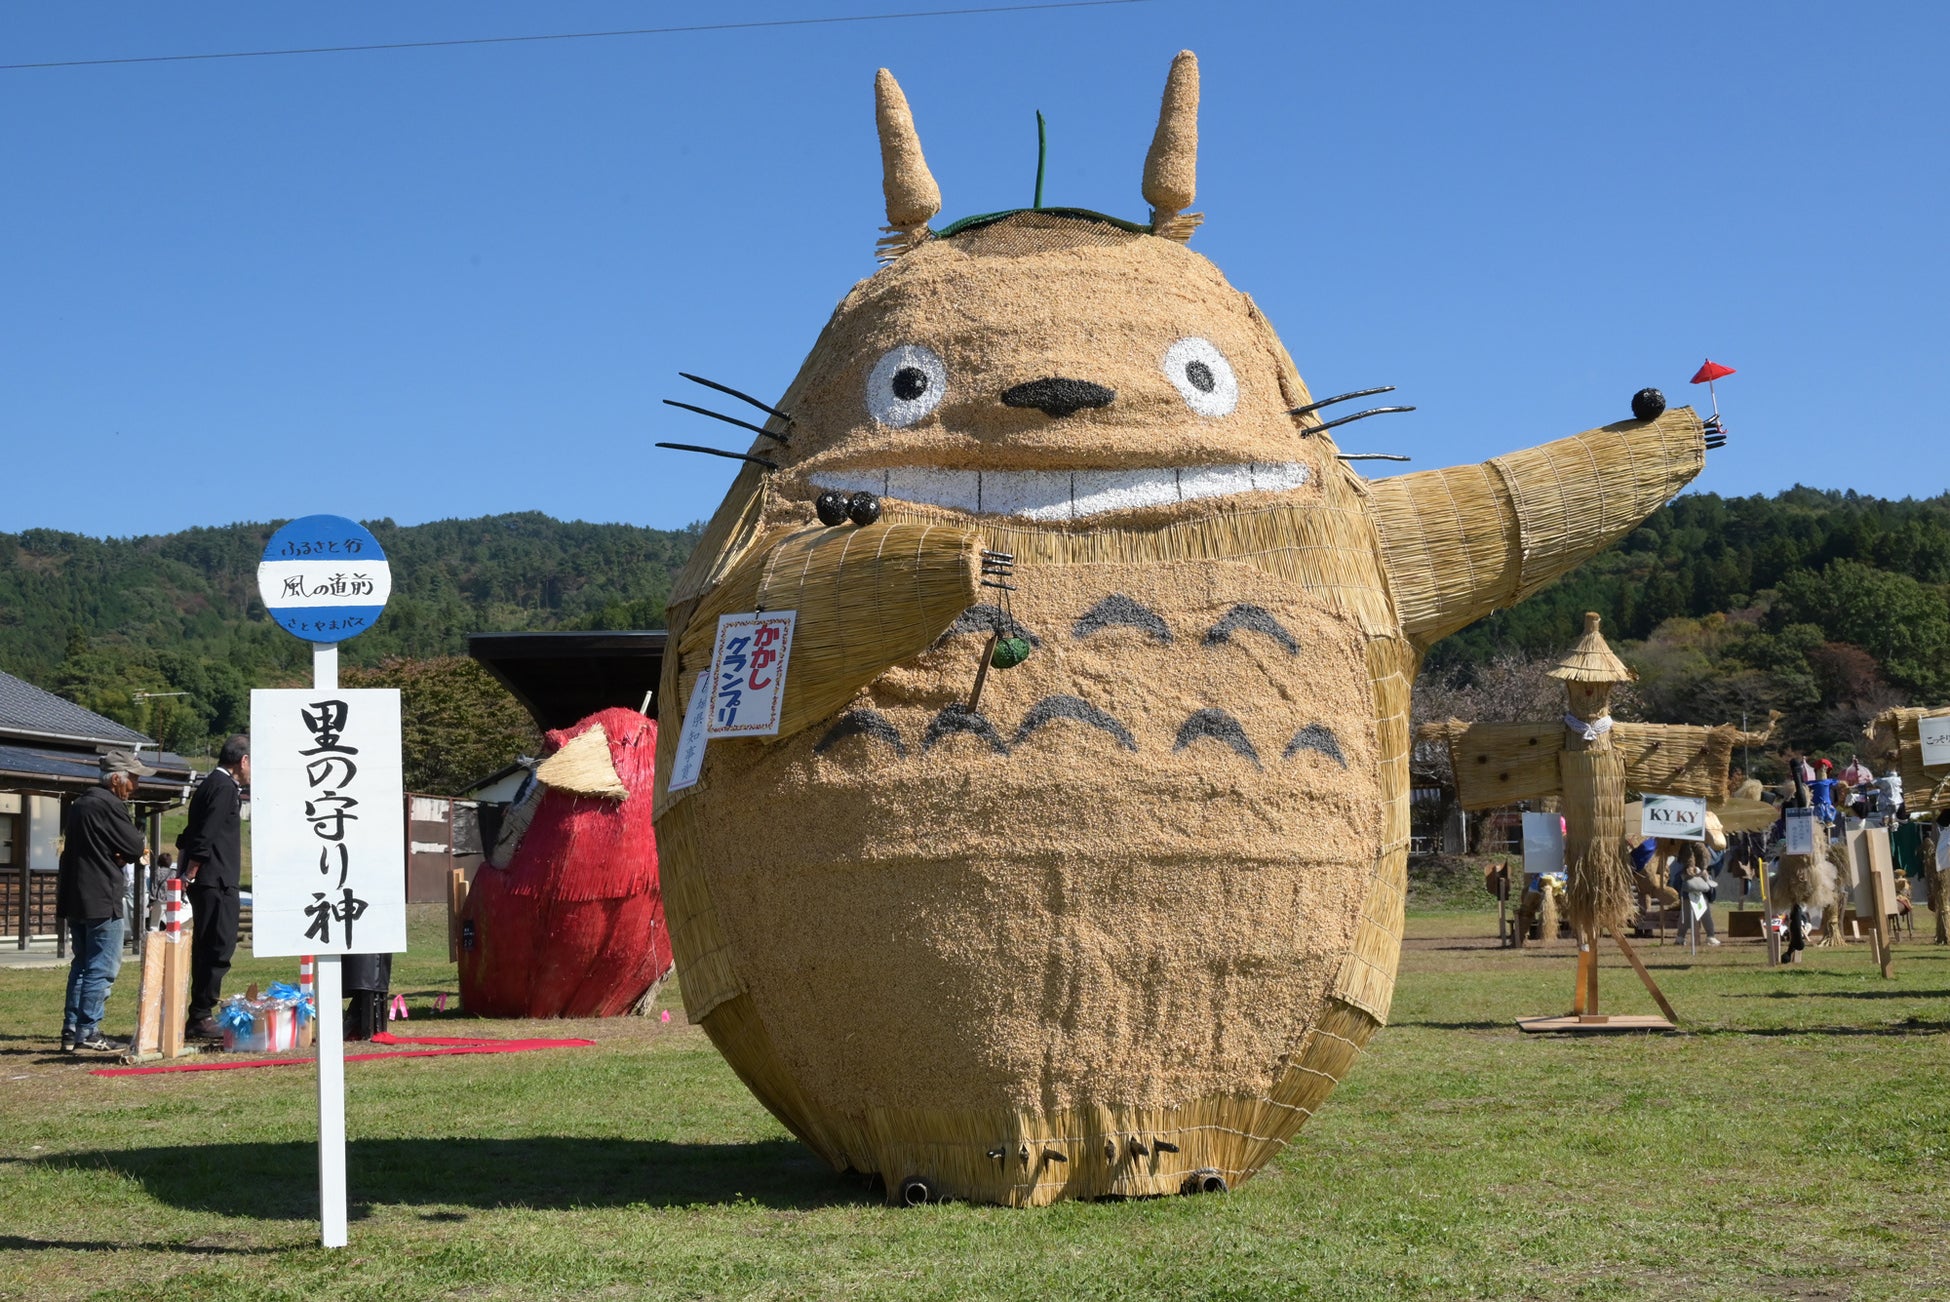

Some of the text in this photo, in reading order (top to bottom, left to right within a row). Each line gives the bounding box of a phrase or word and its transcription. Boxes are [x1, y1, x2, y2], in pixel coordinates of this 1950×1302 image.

[281, 539, 364, 556] ふるさと行
[281, 573, 374, 599] 風の道前
[287, 616, 366, 632] さとやまバス
[748, 624, 780, 691] かかし
[718, 636, 751, 727] グランプリ
[298, 700, 369, 950] 里の守り神
